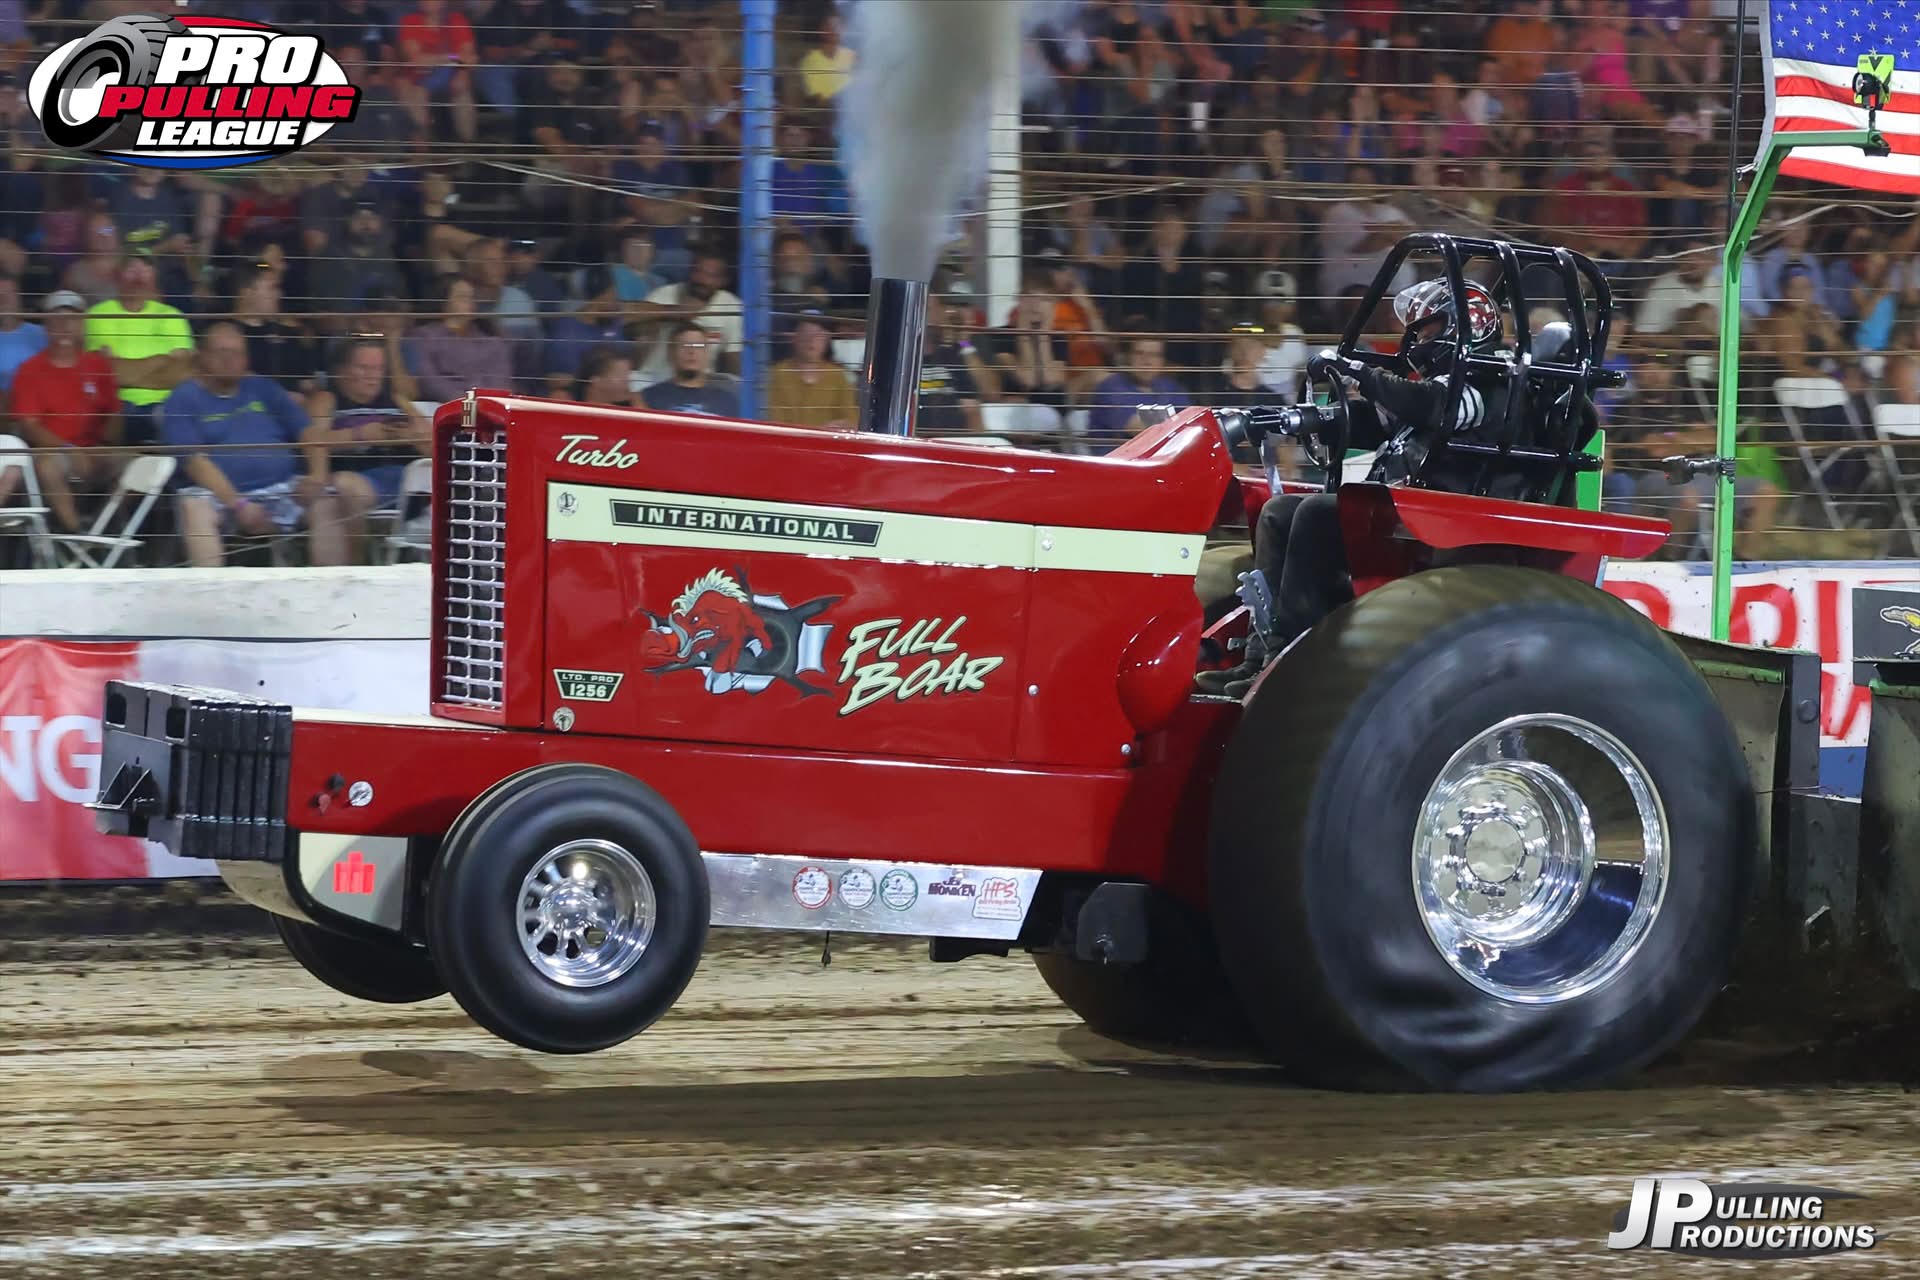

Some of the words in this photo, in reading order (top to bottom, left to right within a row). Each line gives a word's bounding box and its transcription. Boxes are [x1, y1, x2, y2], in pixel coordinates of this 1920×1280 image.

[555, 434, 640, 470] Turbo
[636, 505, 855, 542] INTERNATIONAL
[838, 615, 968, 684] FULL
[561, 673, 586, 681] LTD.
[591, 675, 615, 683] PRO
[569, 683, 607, 698] 1256
[838, 652, 1004, 716] BOAR
